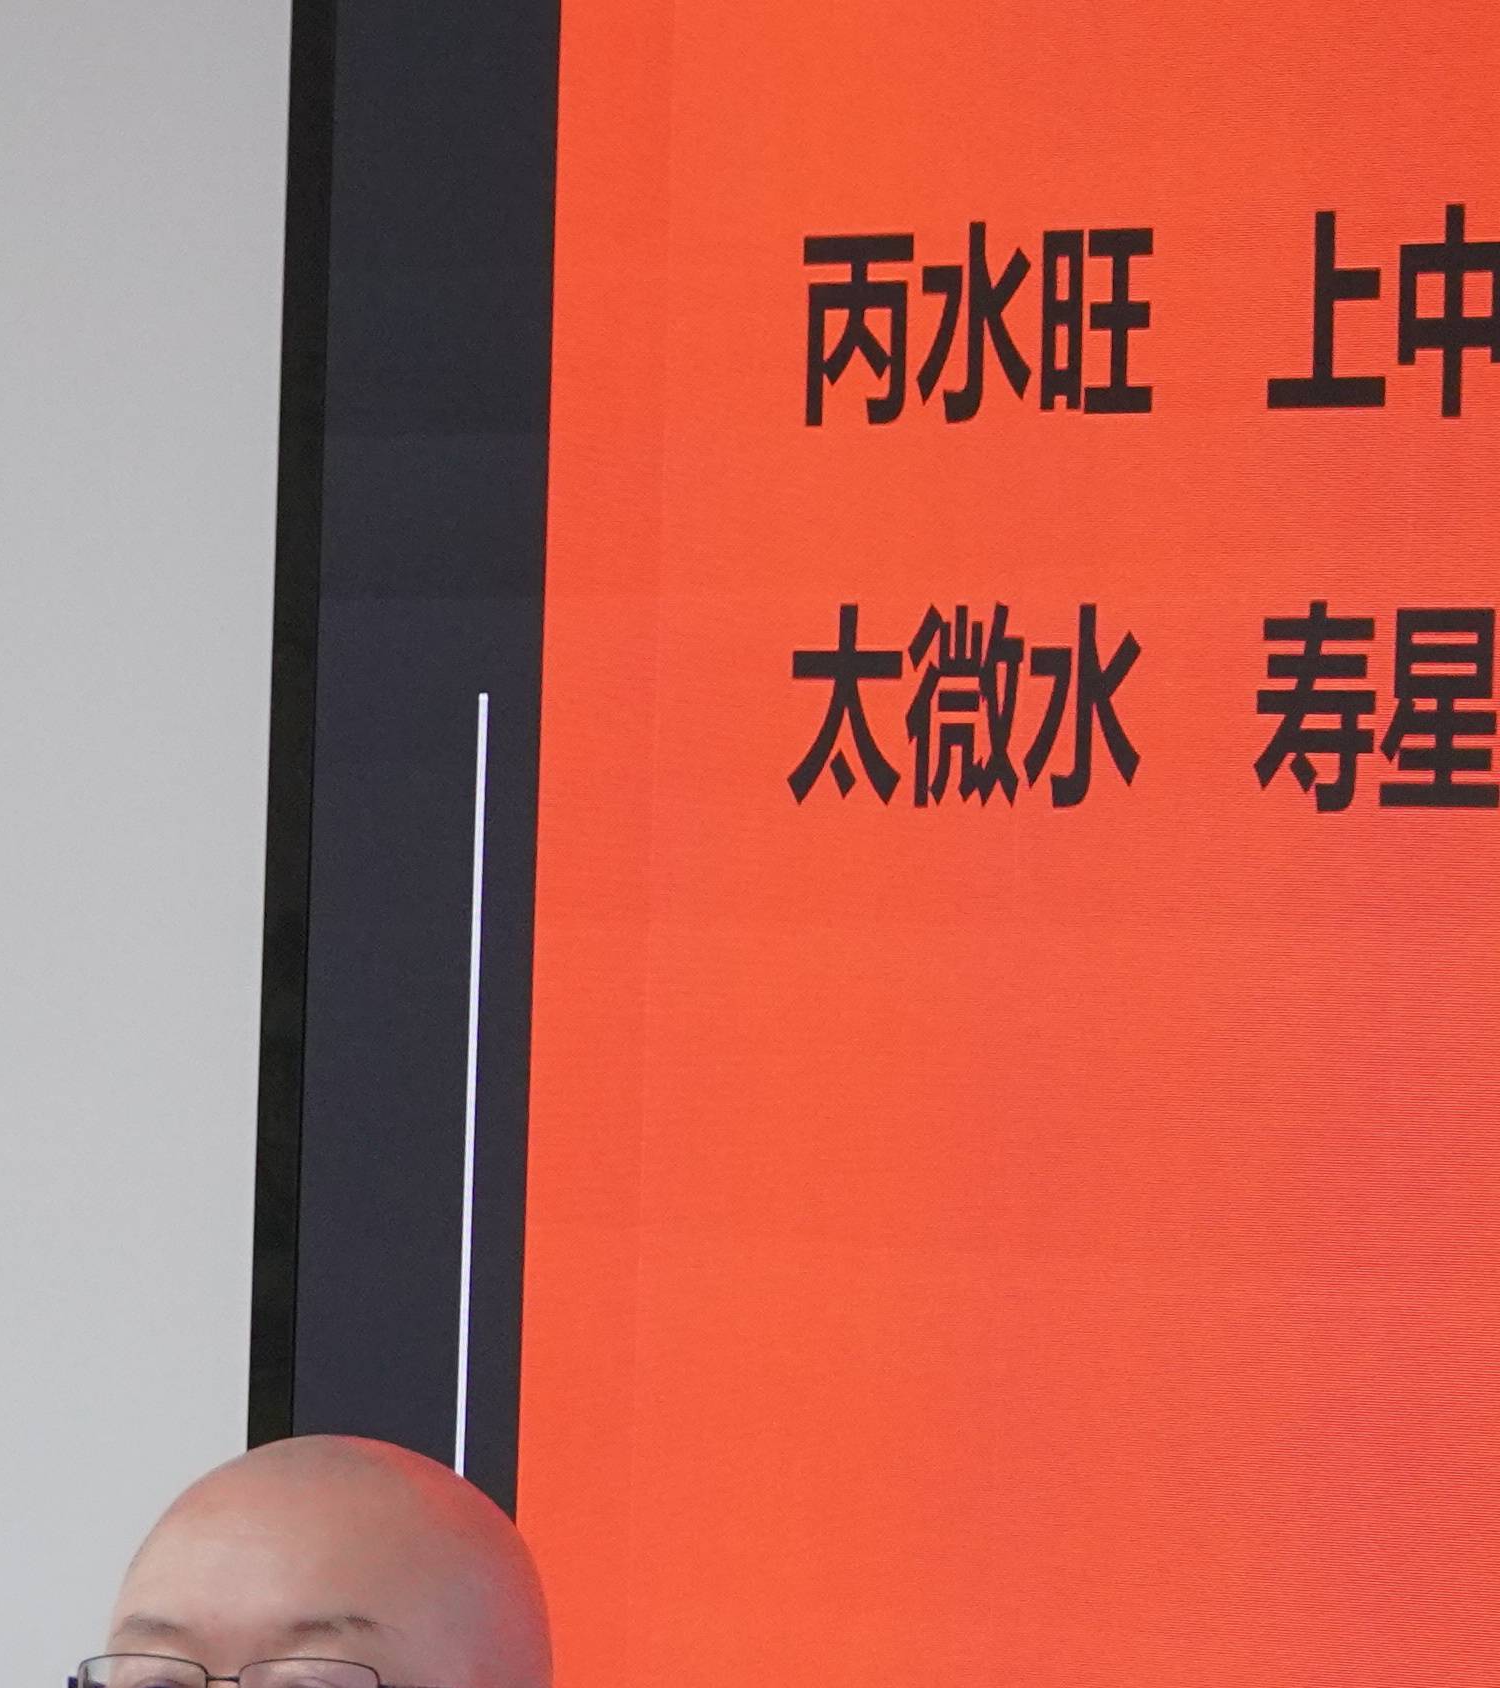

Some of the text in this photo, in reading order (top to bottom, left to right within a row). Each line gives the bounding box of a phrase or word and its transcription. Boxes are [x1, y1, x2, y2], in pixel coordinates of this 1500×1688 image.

[803, 204, 1500, 426] 丙水旺 上中
[787, 602, 1500, 812] 太微水 寿星
